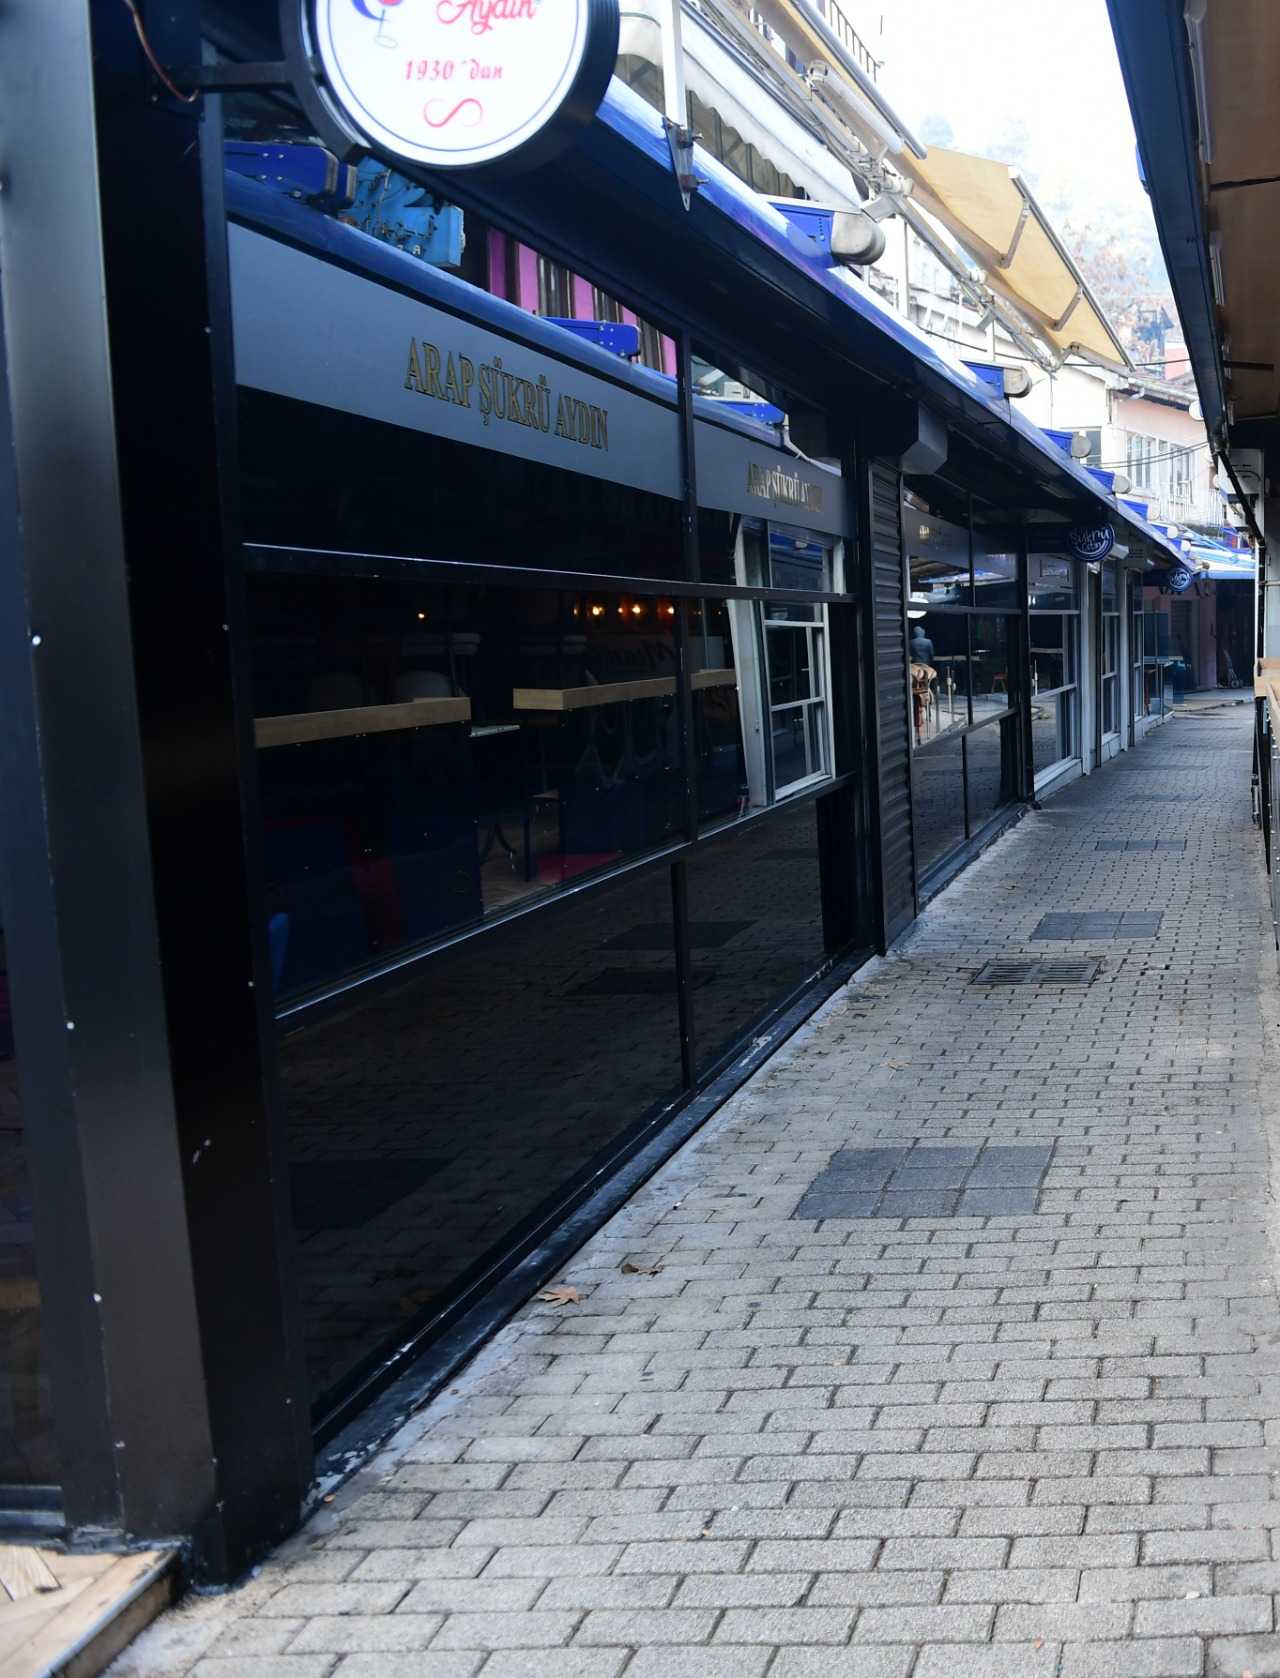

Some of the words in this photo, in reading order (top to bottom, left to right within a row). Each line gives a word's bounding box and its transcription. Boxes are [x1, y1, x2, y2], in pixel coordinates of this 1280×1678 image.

[404, 336, 474, 408] ARAP
[478, 356, 551, 433] ŞÜKRÜ
[554, 392, 608, 452] AYDIN
